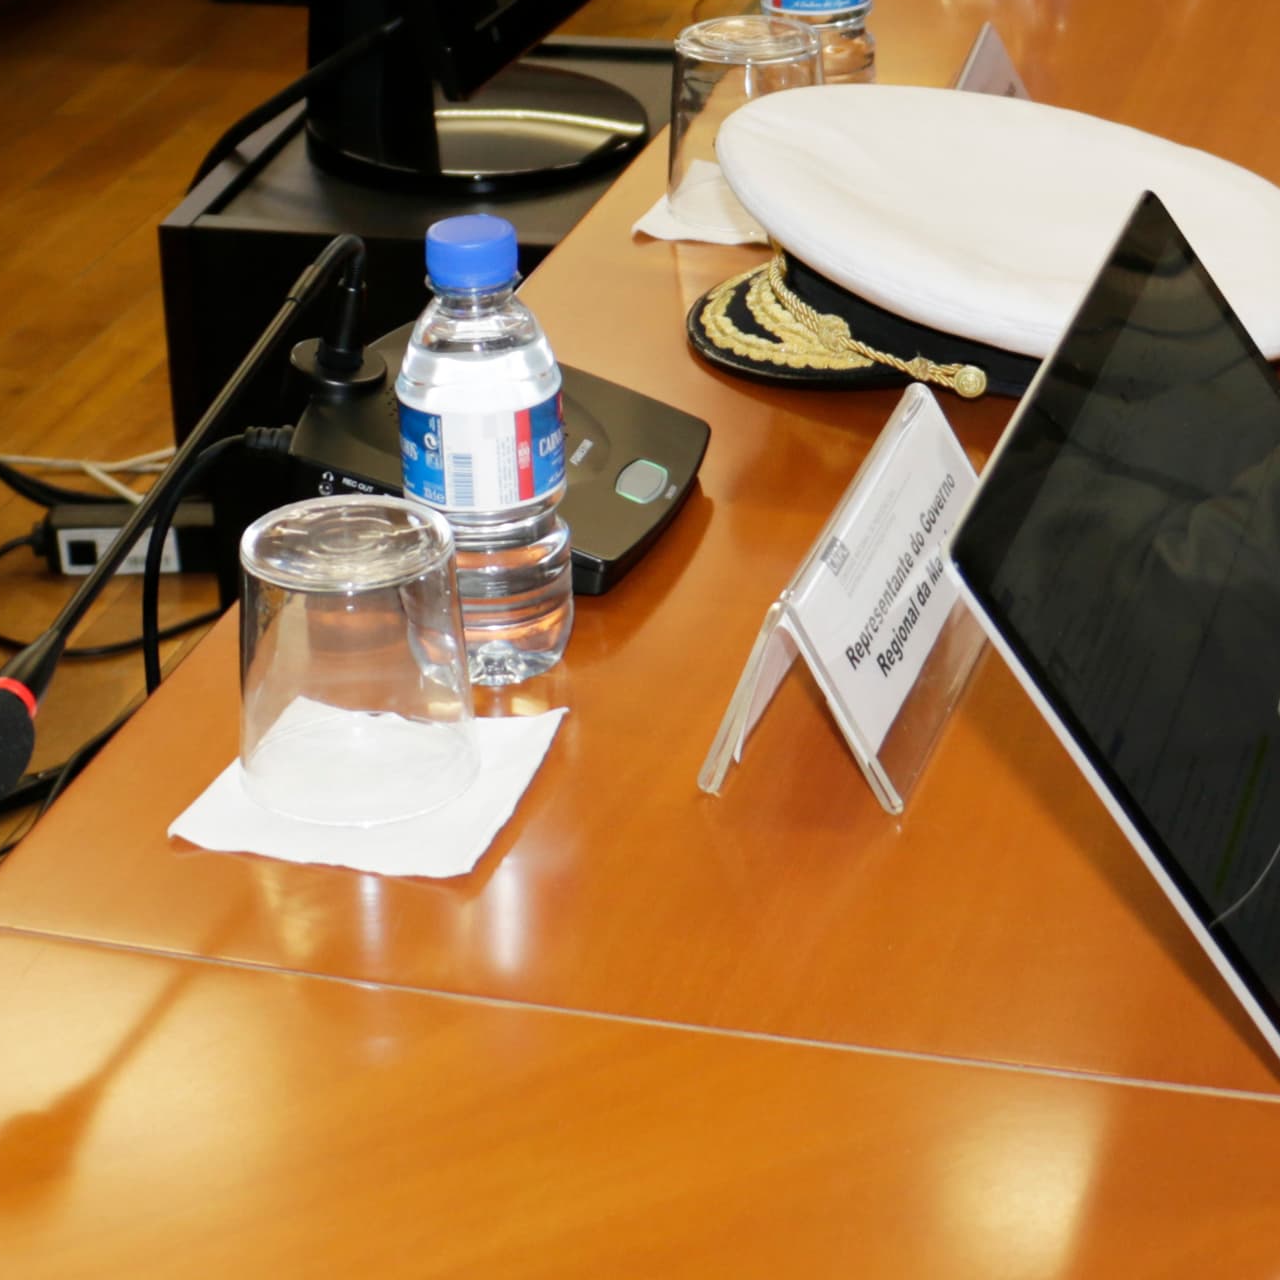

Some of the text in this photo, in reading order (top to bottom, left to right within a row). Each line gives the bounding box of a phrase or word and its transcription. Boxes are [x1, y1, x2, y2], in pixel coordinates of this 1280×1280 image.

[342, 476, 374, 493] REC OUT
[845, 472, 956, 670] Representante do Governo
[876, 597, 920, 678] Regional
[917, 583, 932, 608] da
